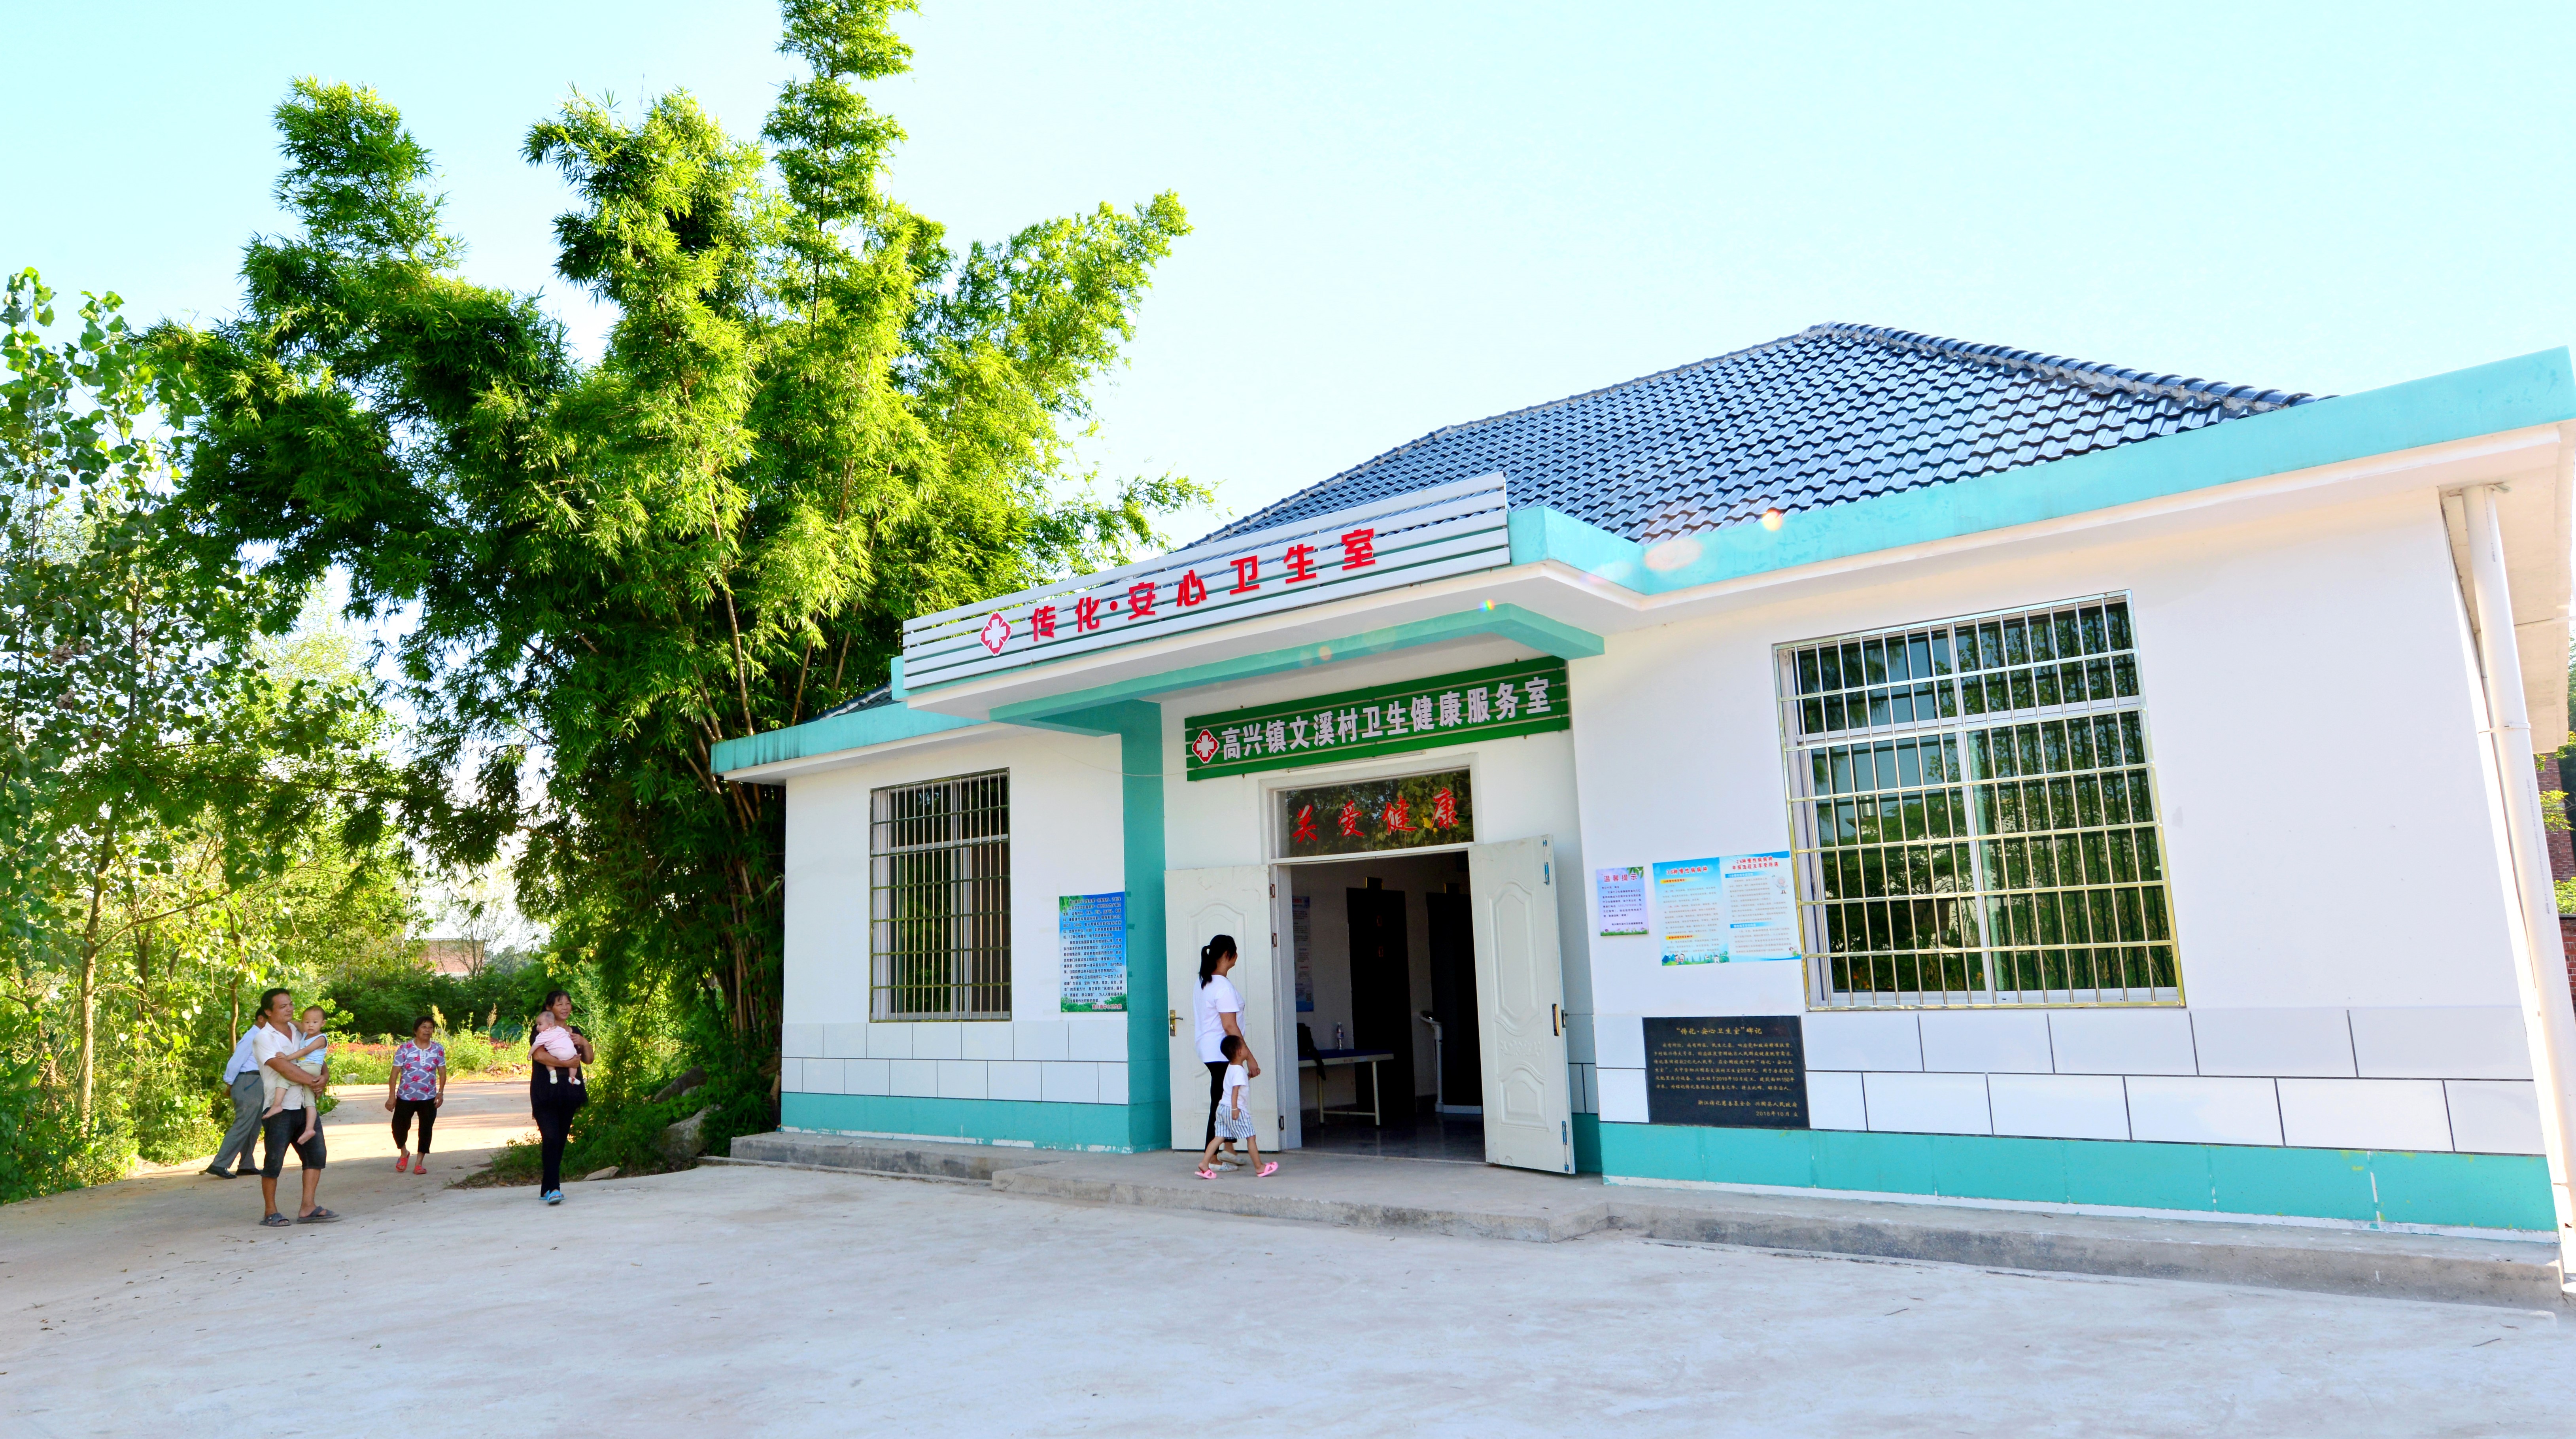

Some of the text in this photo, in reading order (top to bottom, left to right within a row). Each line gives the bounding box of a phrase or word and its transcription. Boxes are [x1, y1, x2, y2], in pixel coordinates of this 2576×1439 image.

[1030, 527, 1376, 642] 传化·安心卫生室
[1222, 676, 1551, 760] 高兴镇文溪村卫生健康服务室
[1292, 787, 1460, 843] 关爱健康
[1604, 874, 1637, 882] 温馨提示
